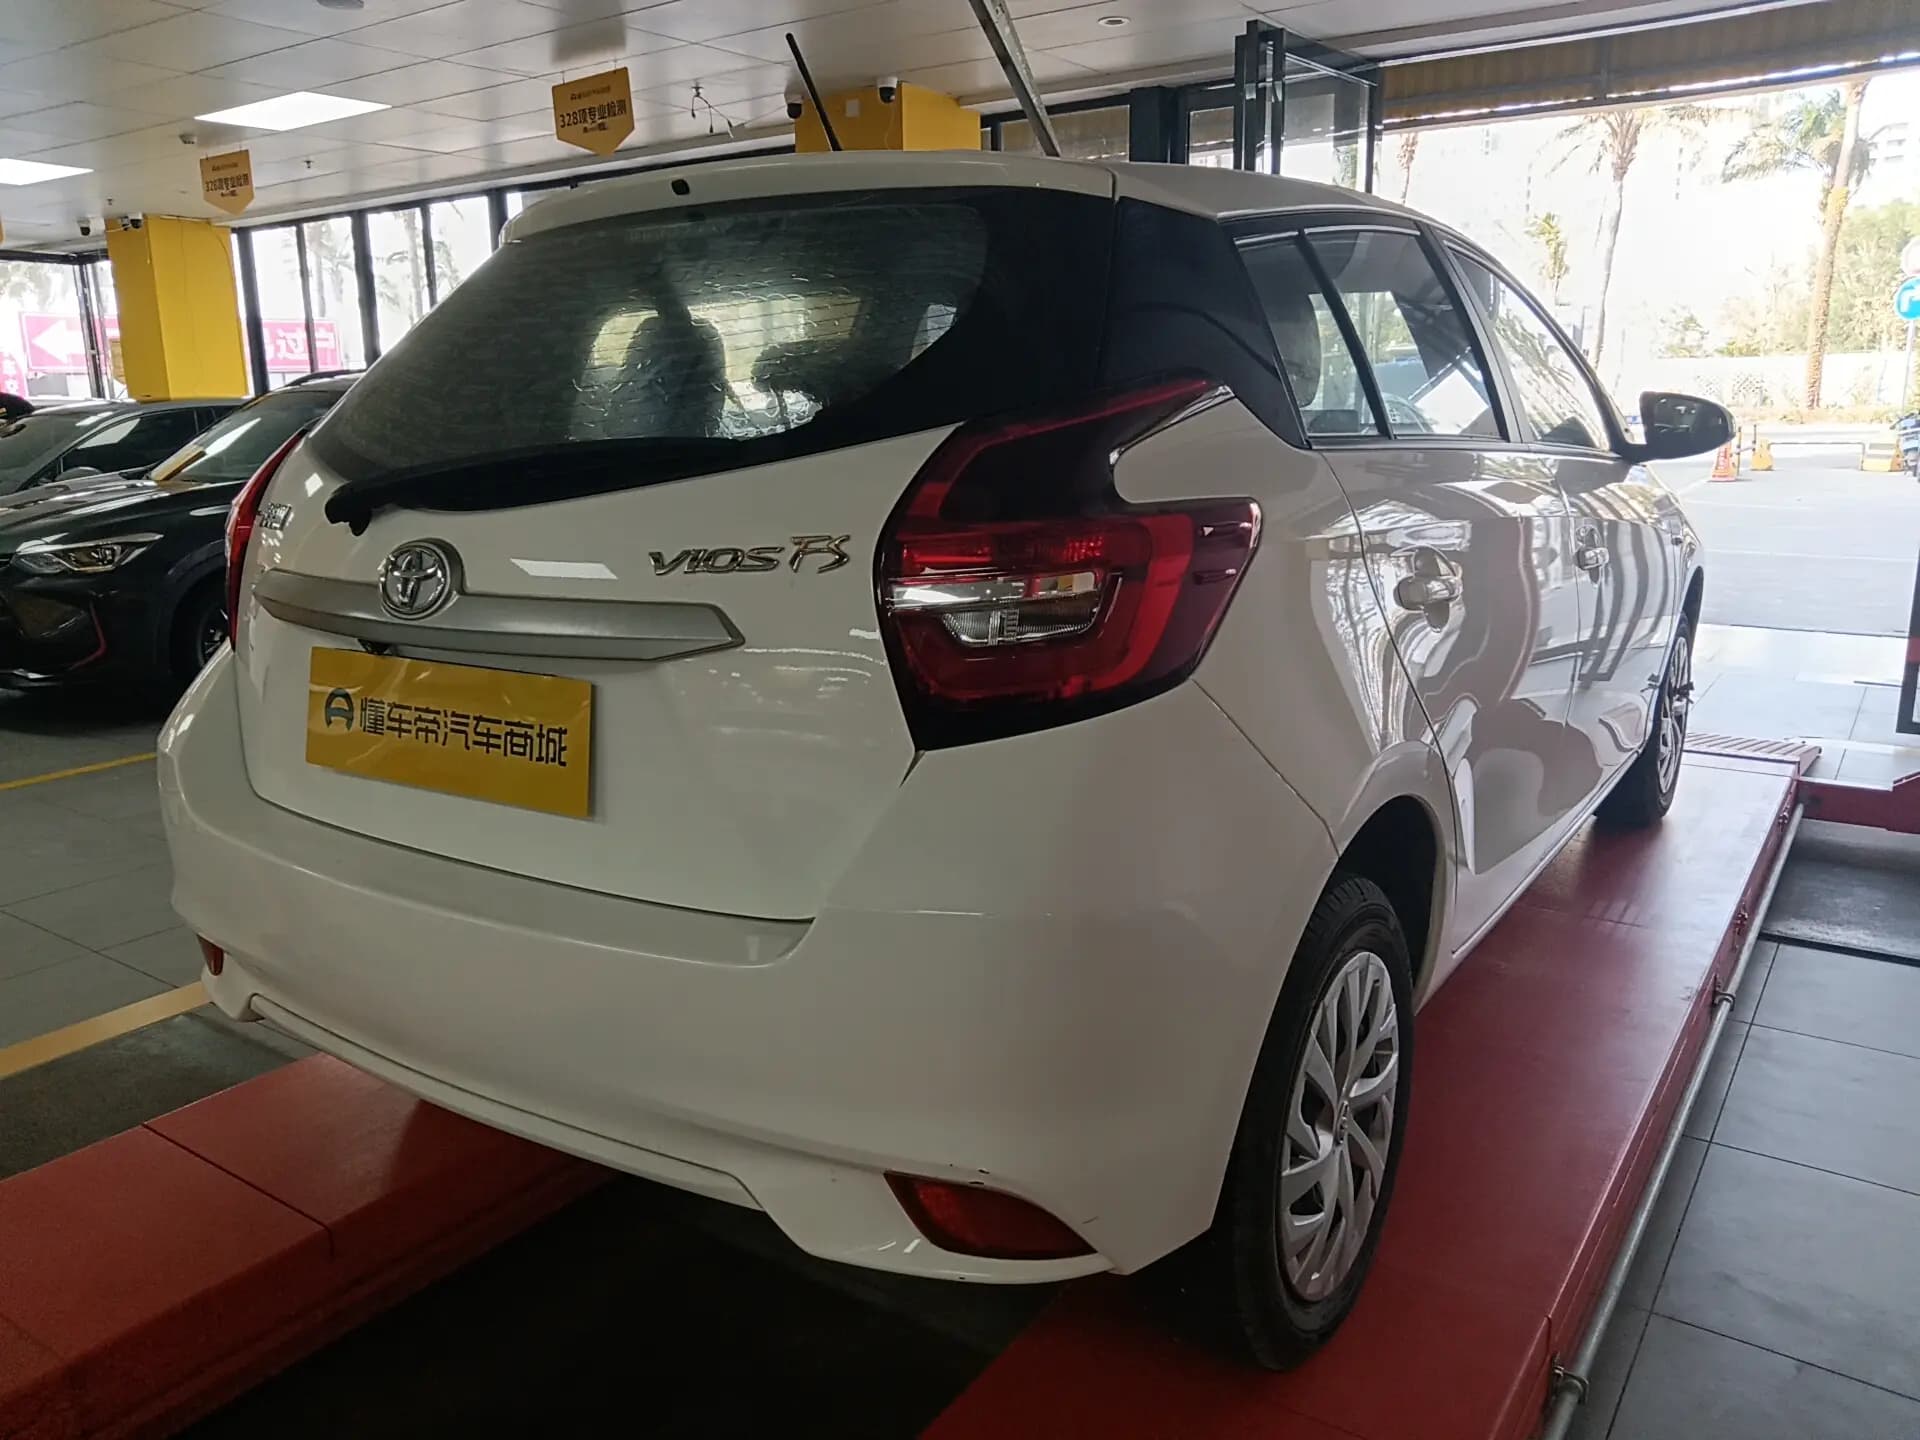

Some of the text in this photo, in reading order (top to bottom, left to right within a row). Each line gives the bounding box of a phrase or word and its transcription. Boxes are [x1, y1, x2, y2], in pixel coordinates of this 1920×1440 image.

[649, 534, 851, 576] VIOS FS
[360, 696, 568, 767] 懂车帝汽车商城
